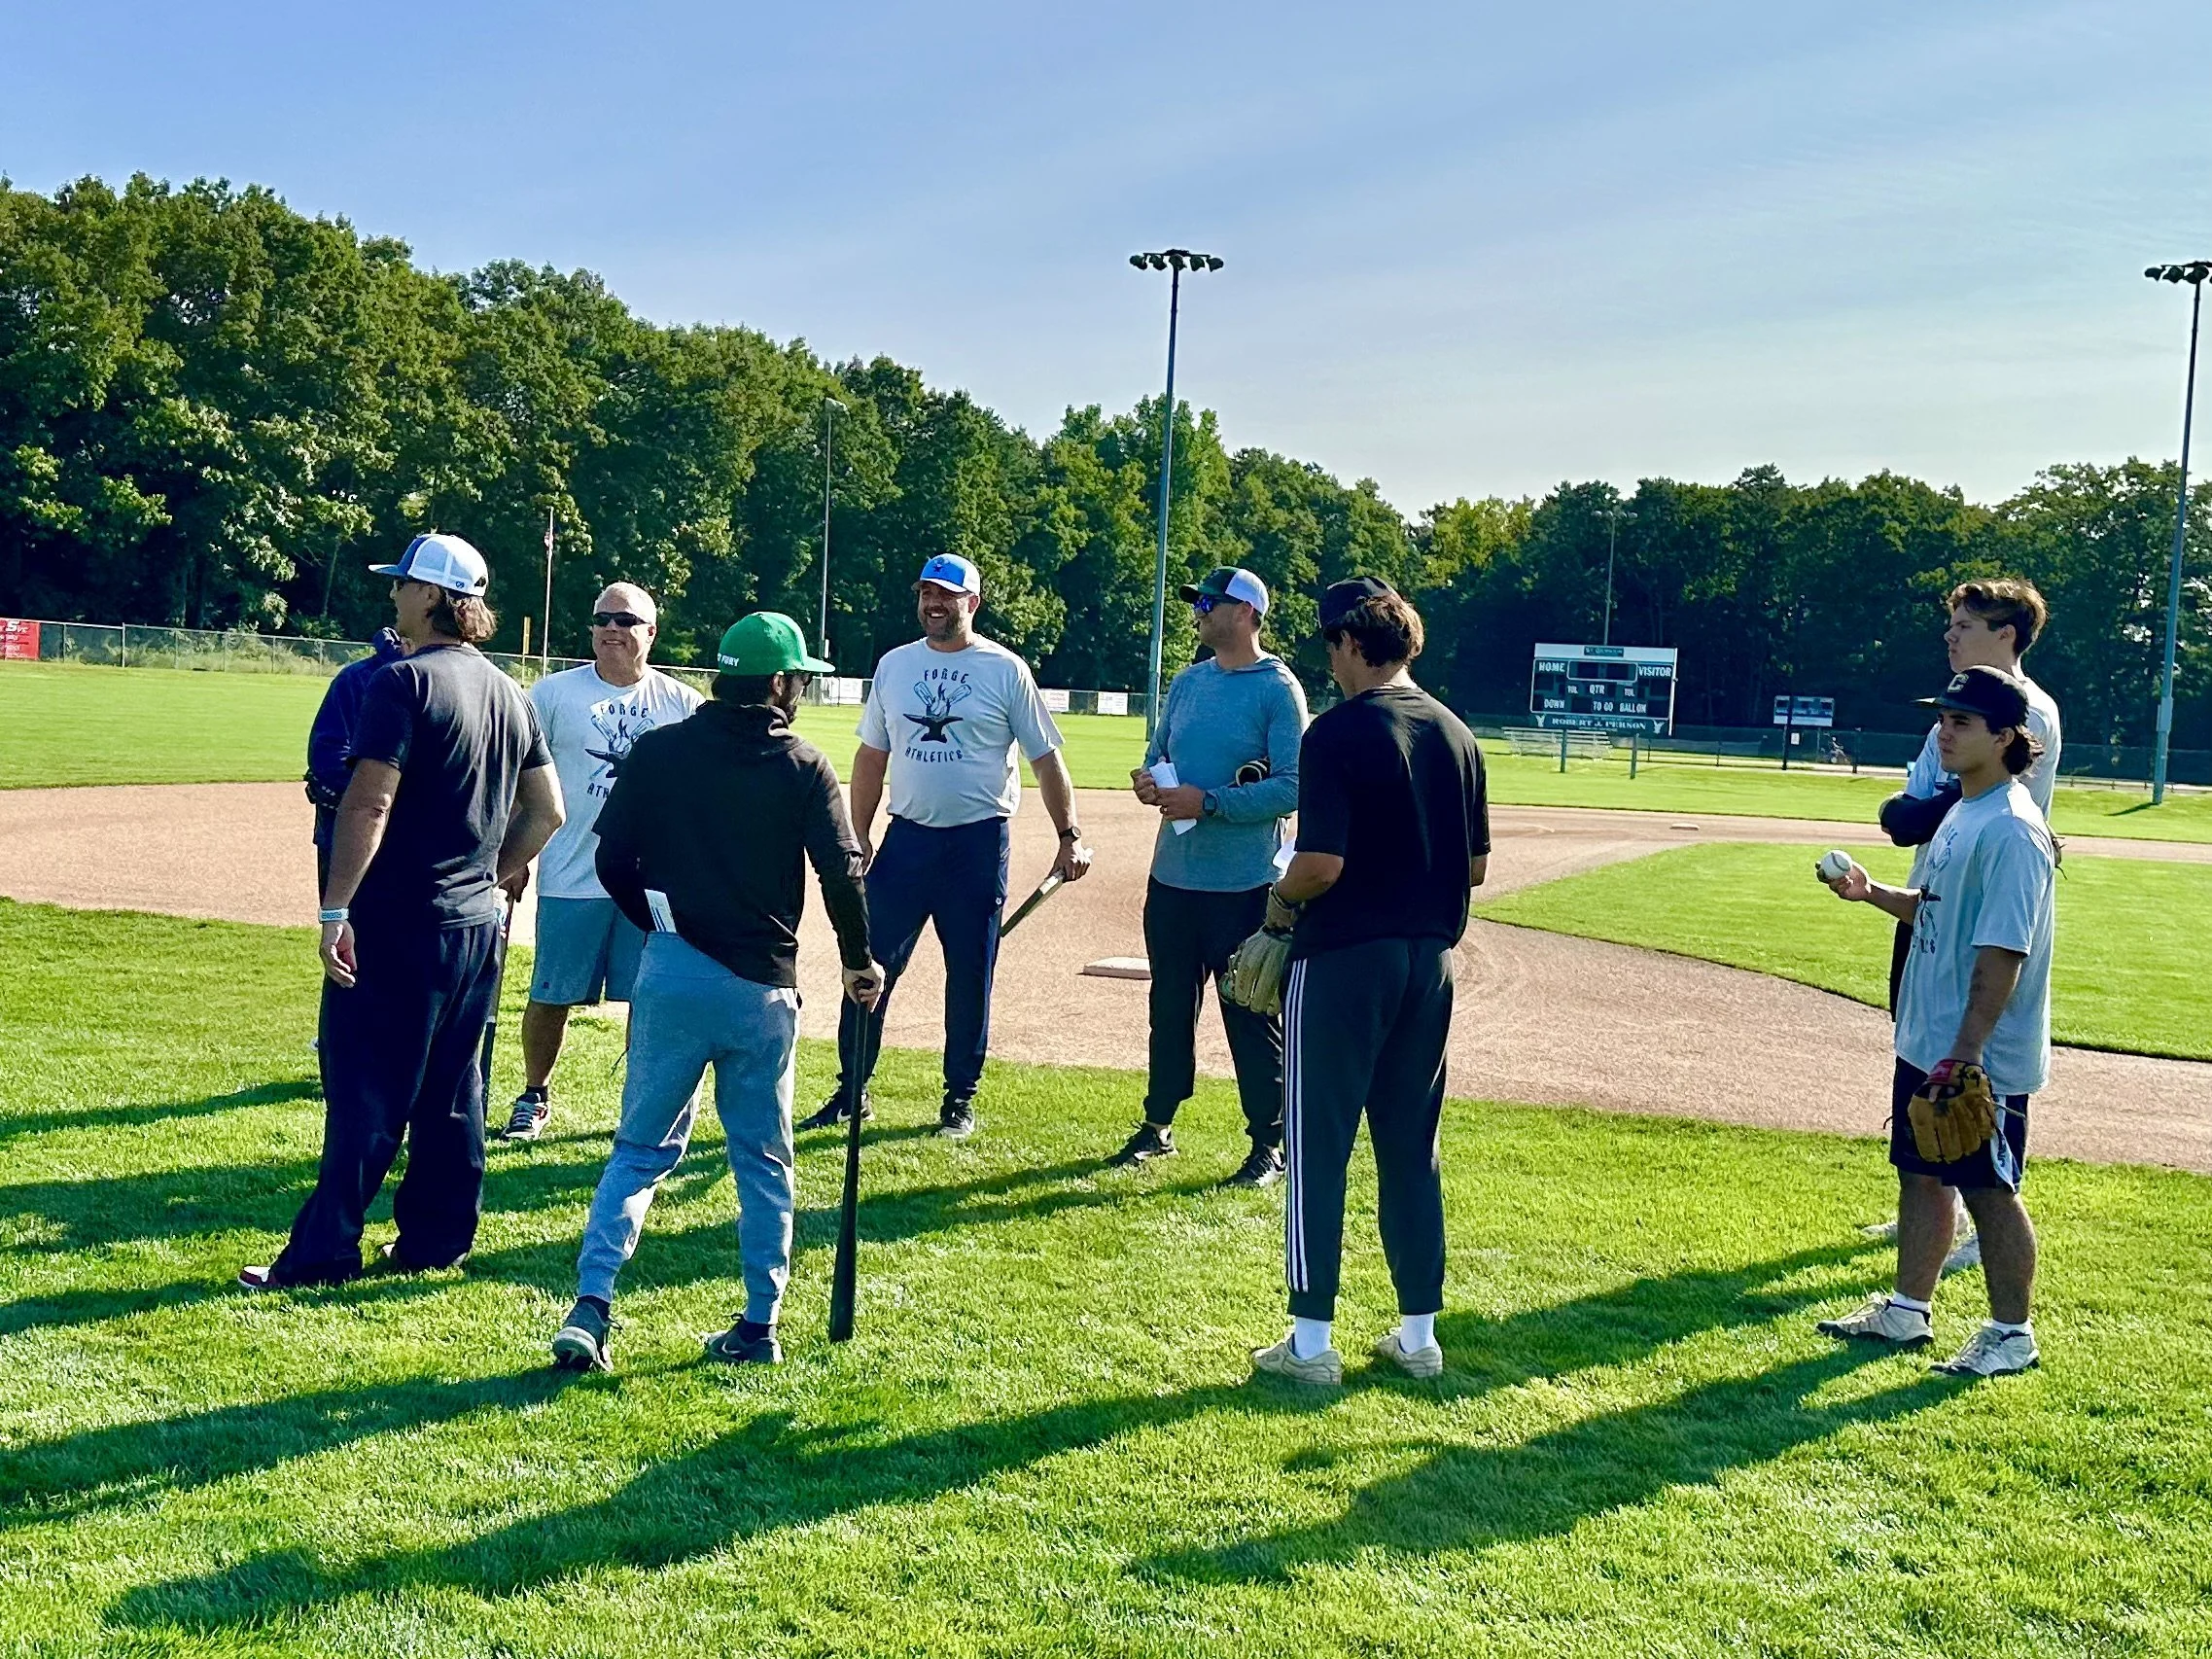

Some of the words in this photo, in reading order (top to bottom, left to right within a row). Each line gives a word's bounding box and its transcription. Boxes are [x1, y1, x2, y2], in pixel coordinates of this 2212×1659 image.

[924, 668, 969, 684] FORGE
[1538, 661, 1565, 672] HOME
[1637, 666, 1672, 677] VISITOR
[1589, 684, 1605, 695] QTR
[1948, 673, 1970, 693] C
[600, 703, 649, 719] FORGE
[1544, 698, 1565, 709] DOWN
[1593, 700, 1602, 711] TO
[1603, 701, 1614, 712] GO
[1552, 718, 1593, 726] ROBERT
[904, 746, 964, 763] ATHLETICS
